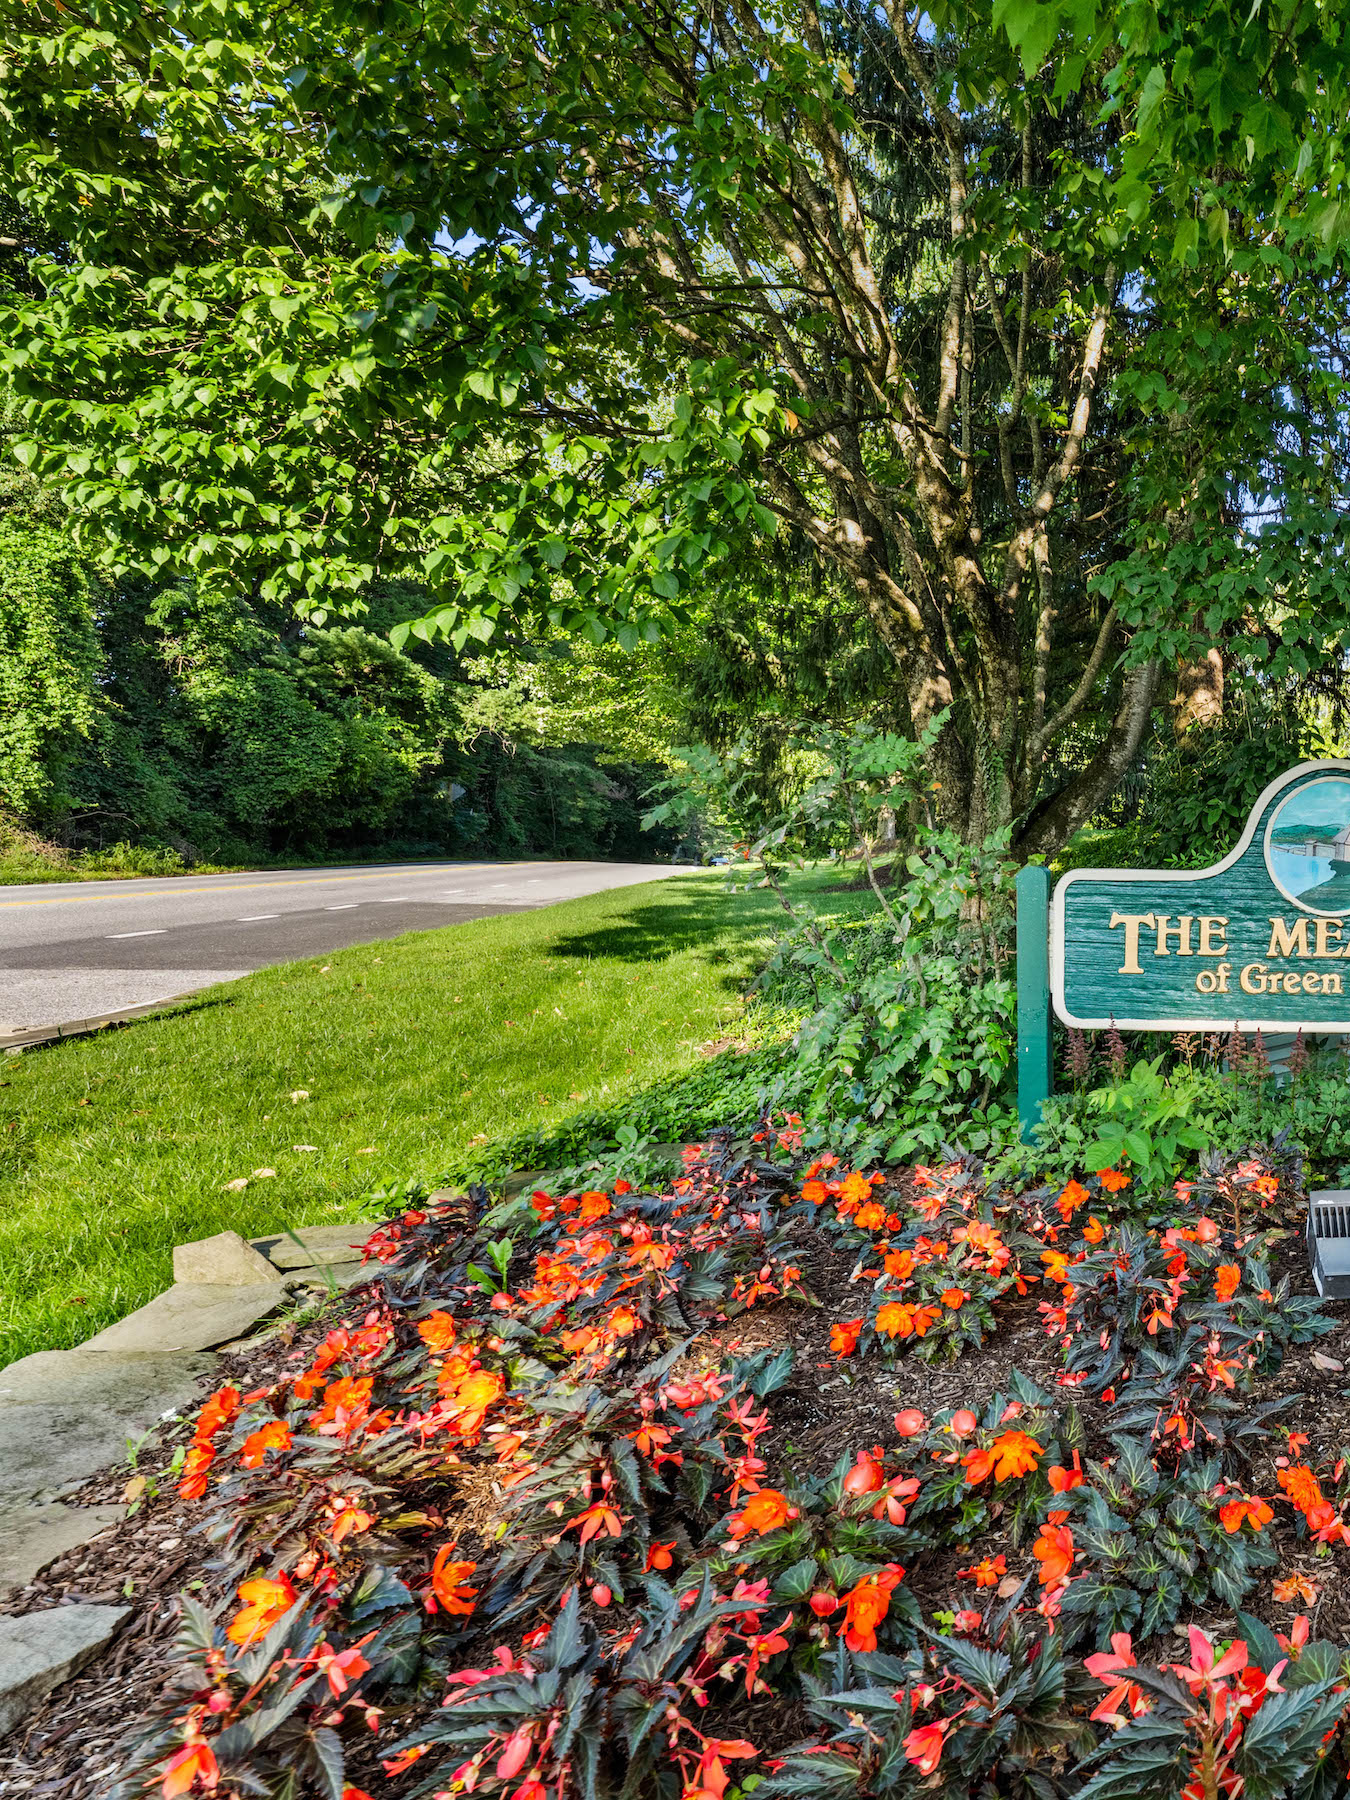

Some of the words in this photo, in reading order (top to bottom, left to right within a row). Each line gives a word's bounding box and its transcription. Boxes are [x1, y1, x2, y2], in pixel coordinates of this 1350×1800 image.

[1108, 911, 1229, 974] THE
[1195, 962, 1232, 994] of
[1239, 964, 1343, 995] Green
